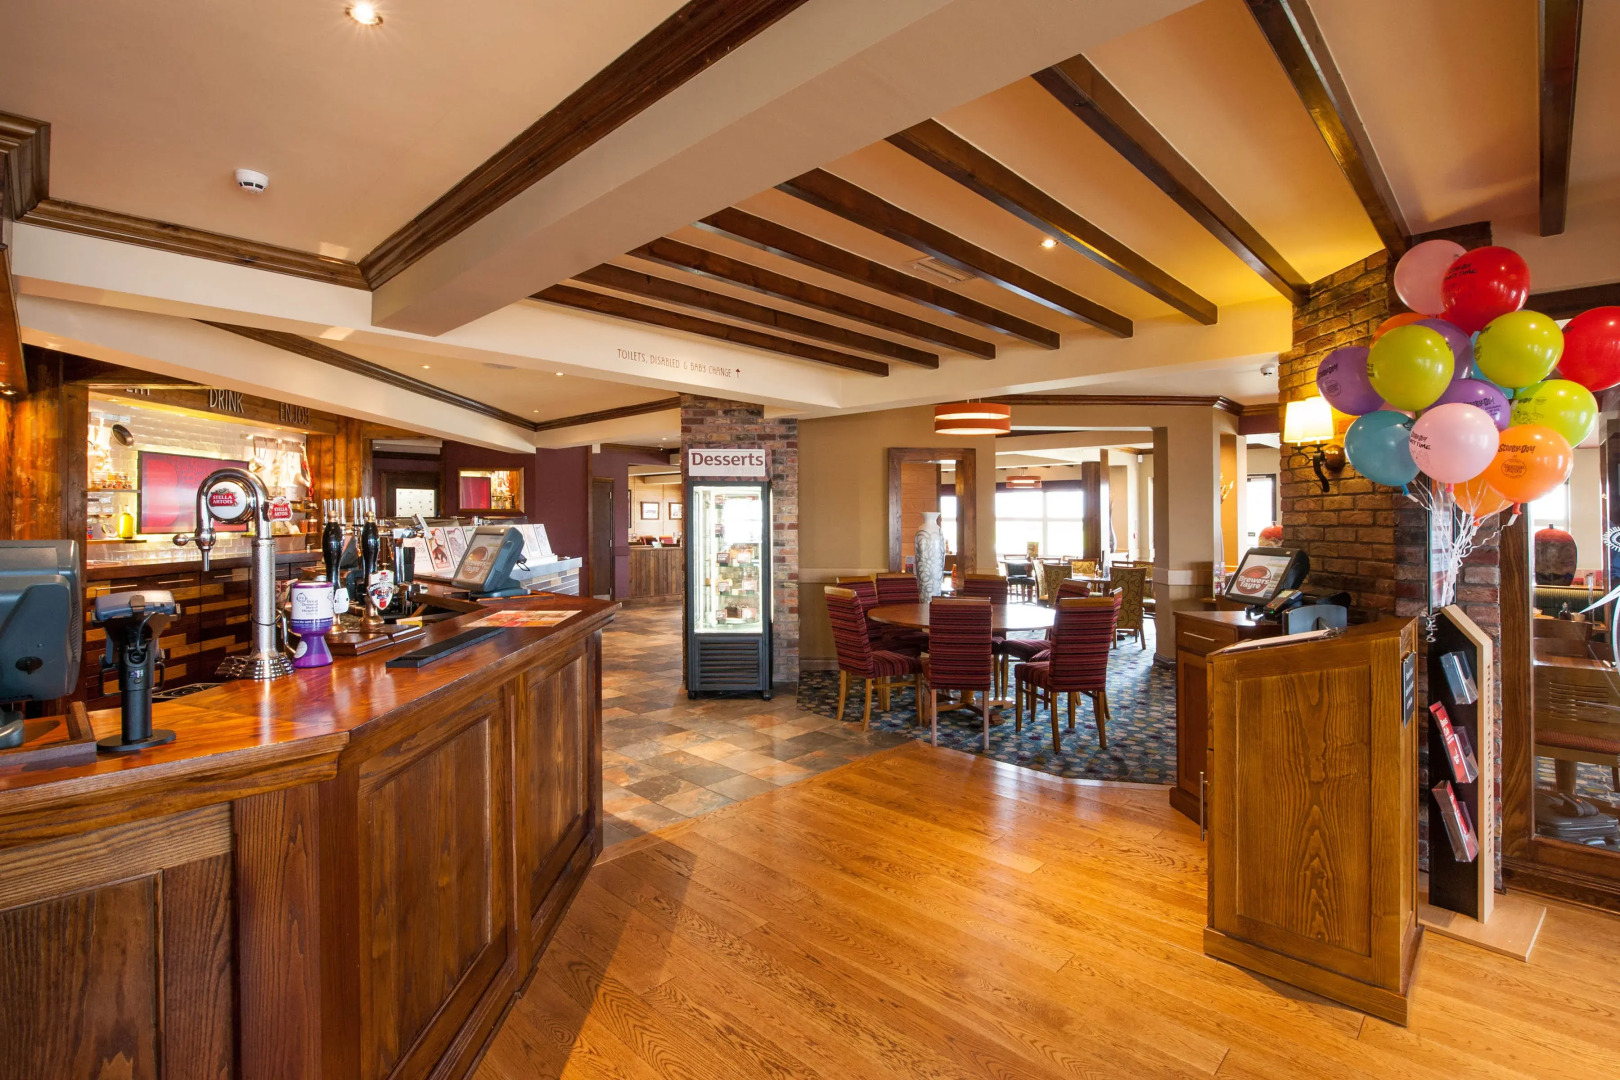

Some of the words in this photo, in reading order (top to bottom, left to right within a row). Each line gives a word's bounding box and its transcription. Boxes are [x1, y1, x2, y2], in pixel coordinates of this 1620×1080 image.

[617, 349, 648, 363] TOILETS,
[650, 354, 680, 369] DISABLED
[690, 362, 706, 374] BABY
[708, 365, 731, 378] CHANGE
[209, 388, 244, 414] DRINK
[279, 402, 311, 425] ENJOY
[691, 452, 764, 466] Desserts
[1238, 575, 1270, 585] Brewers
